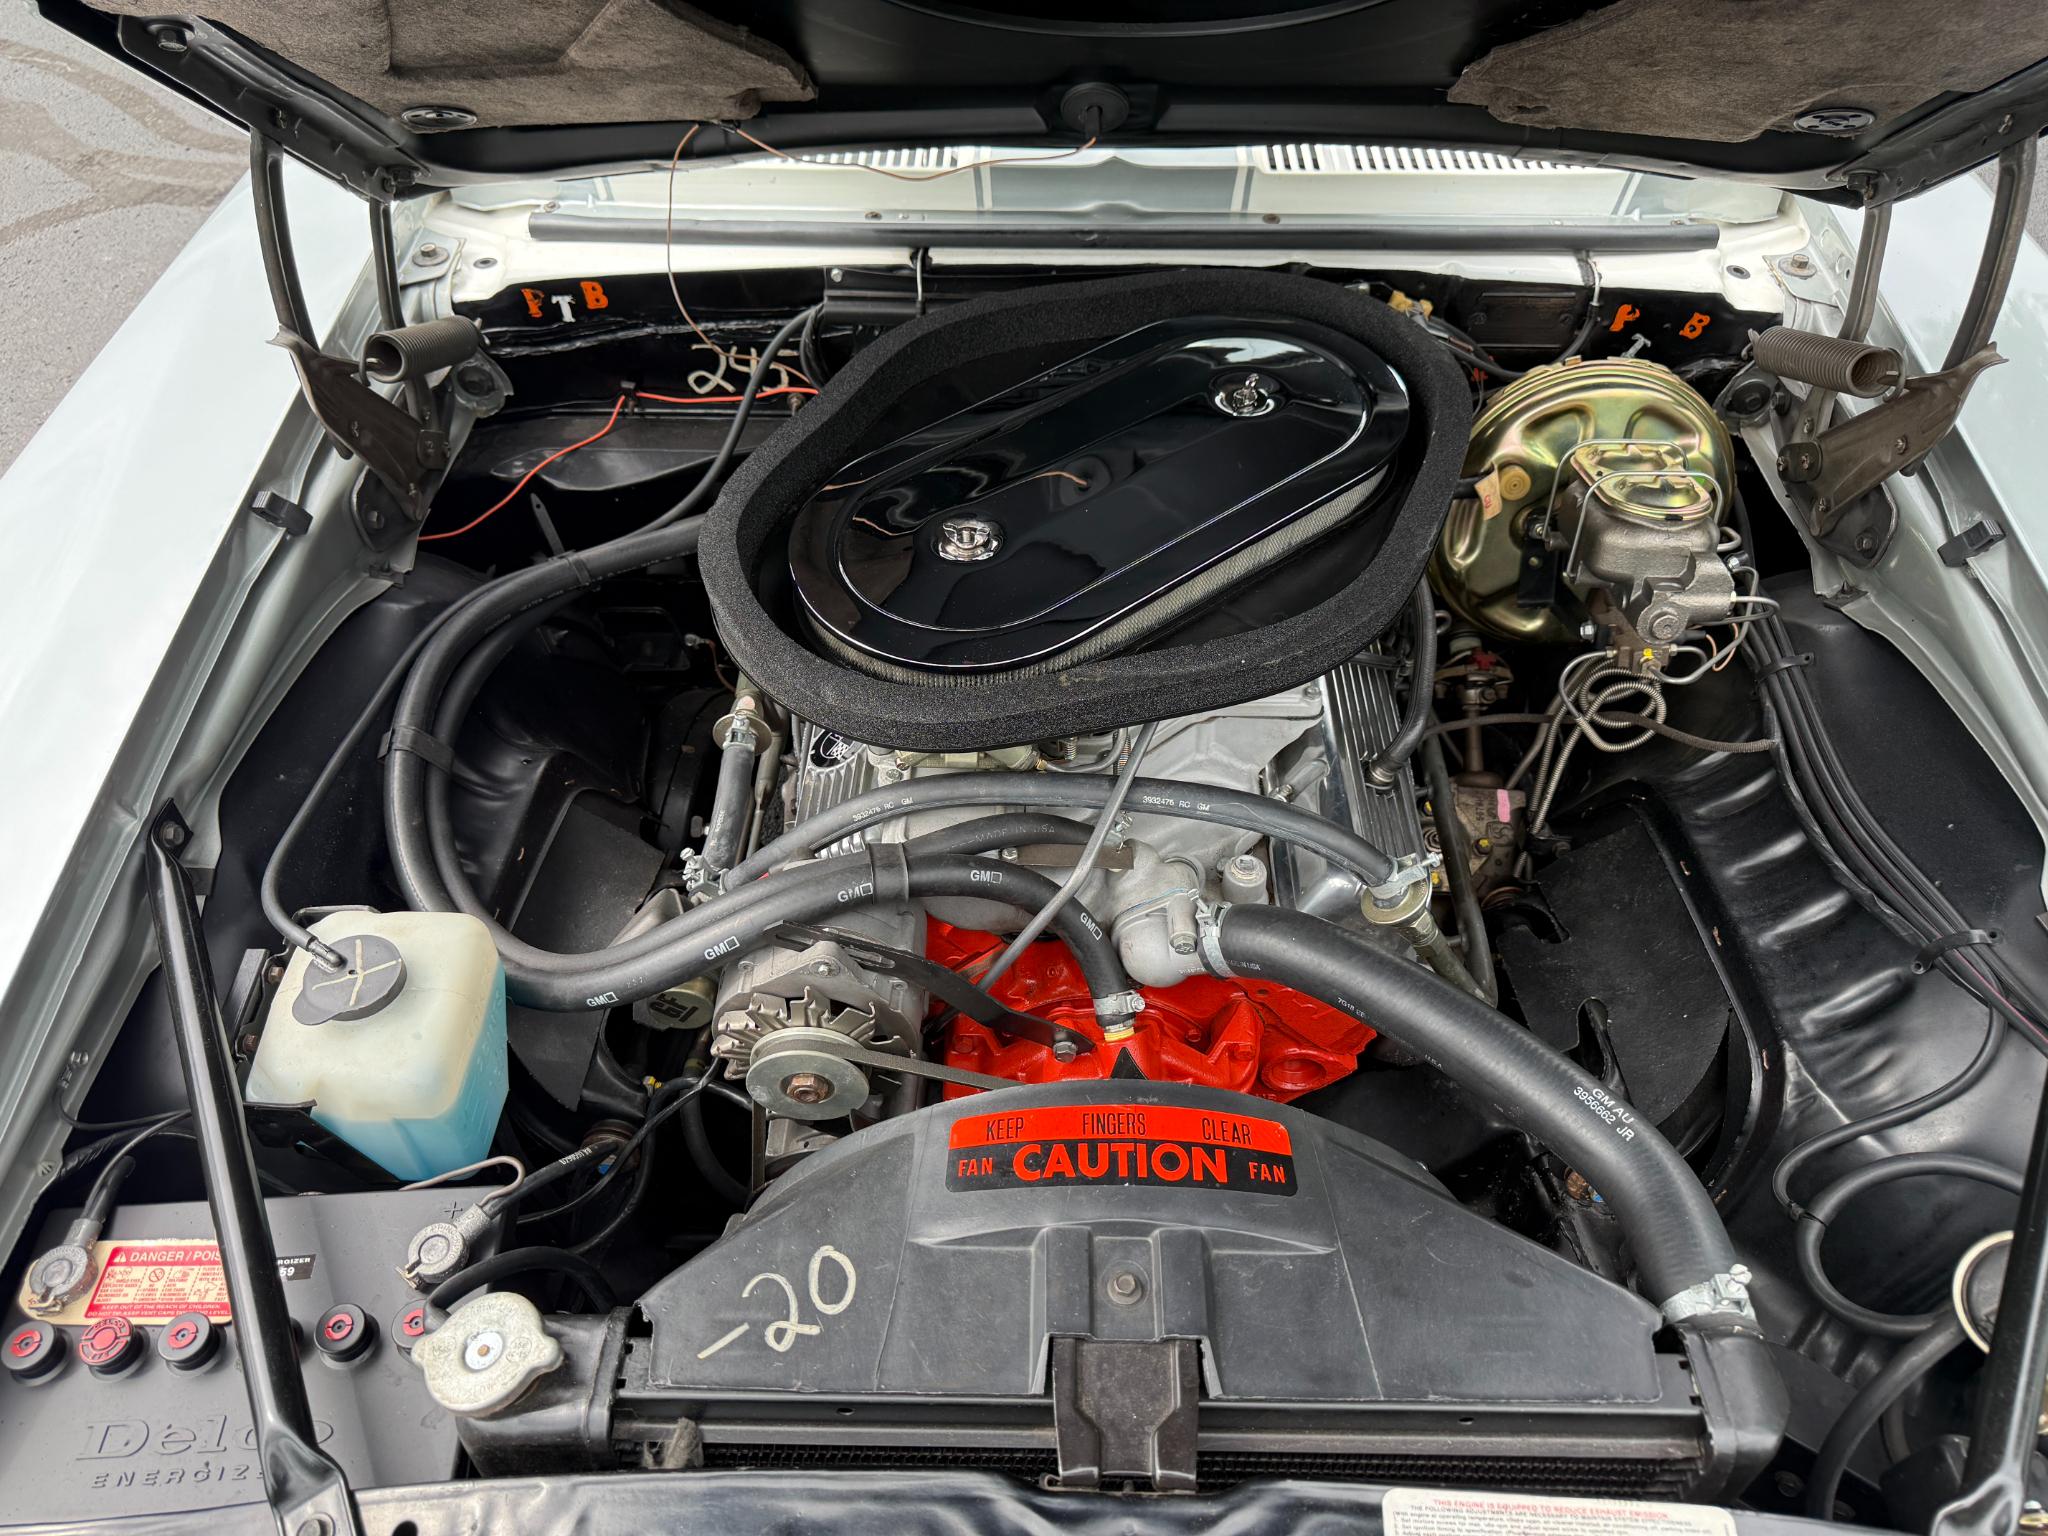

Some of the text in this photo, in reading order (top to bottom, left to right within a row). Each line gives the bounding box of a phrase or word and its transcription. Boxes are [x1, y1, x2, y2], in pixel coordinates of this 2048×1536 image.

[970, 869, 991, 882] GM
[837, 887, 862, 902] GM
[1080, 912, 1096, 932] GM
[703, 941, 728, 960] GM
[586, 995, 607, 1007] GM
[1573, 1086, 1635, 1142] 3956662 JR
[1592, 1088, 1634, 1124] GM AU
[986, 1112, 1251, 1146] KEEP FINGERS CLEAR
[957, 1142, 1286, 1184] FAN CAUTION FAN
[130, 1251, 184, 1262] DANGER
[192, 1250, 222, 1261] POIS
[277, 1257, 311, 1265] RGIZER
[91, 1463, 264, 1488] ENERGIZ
